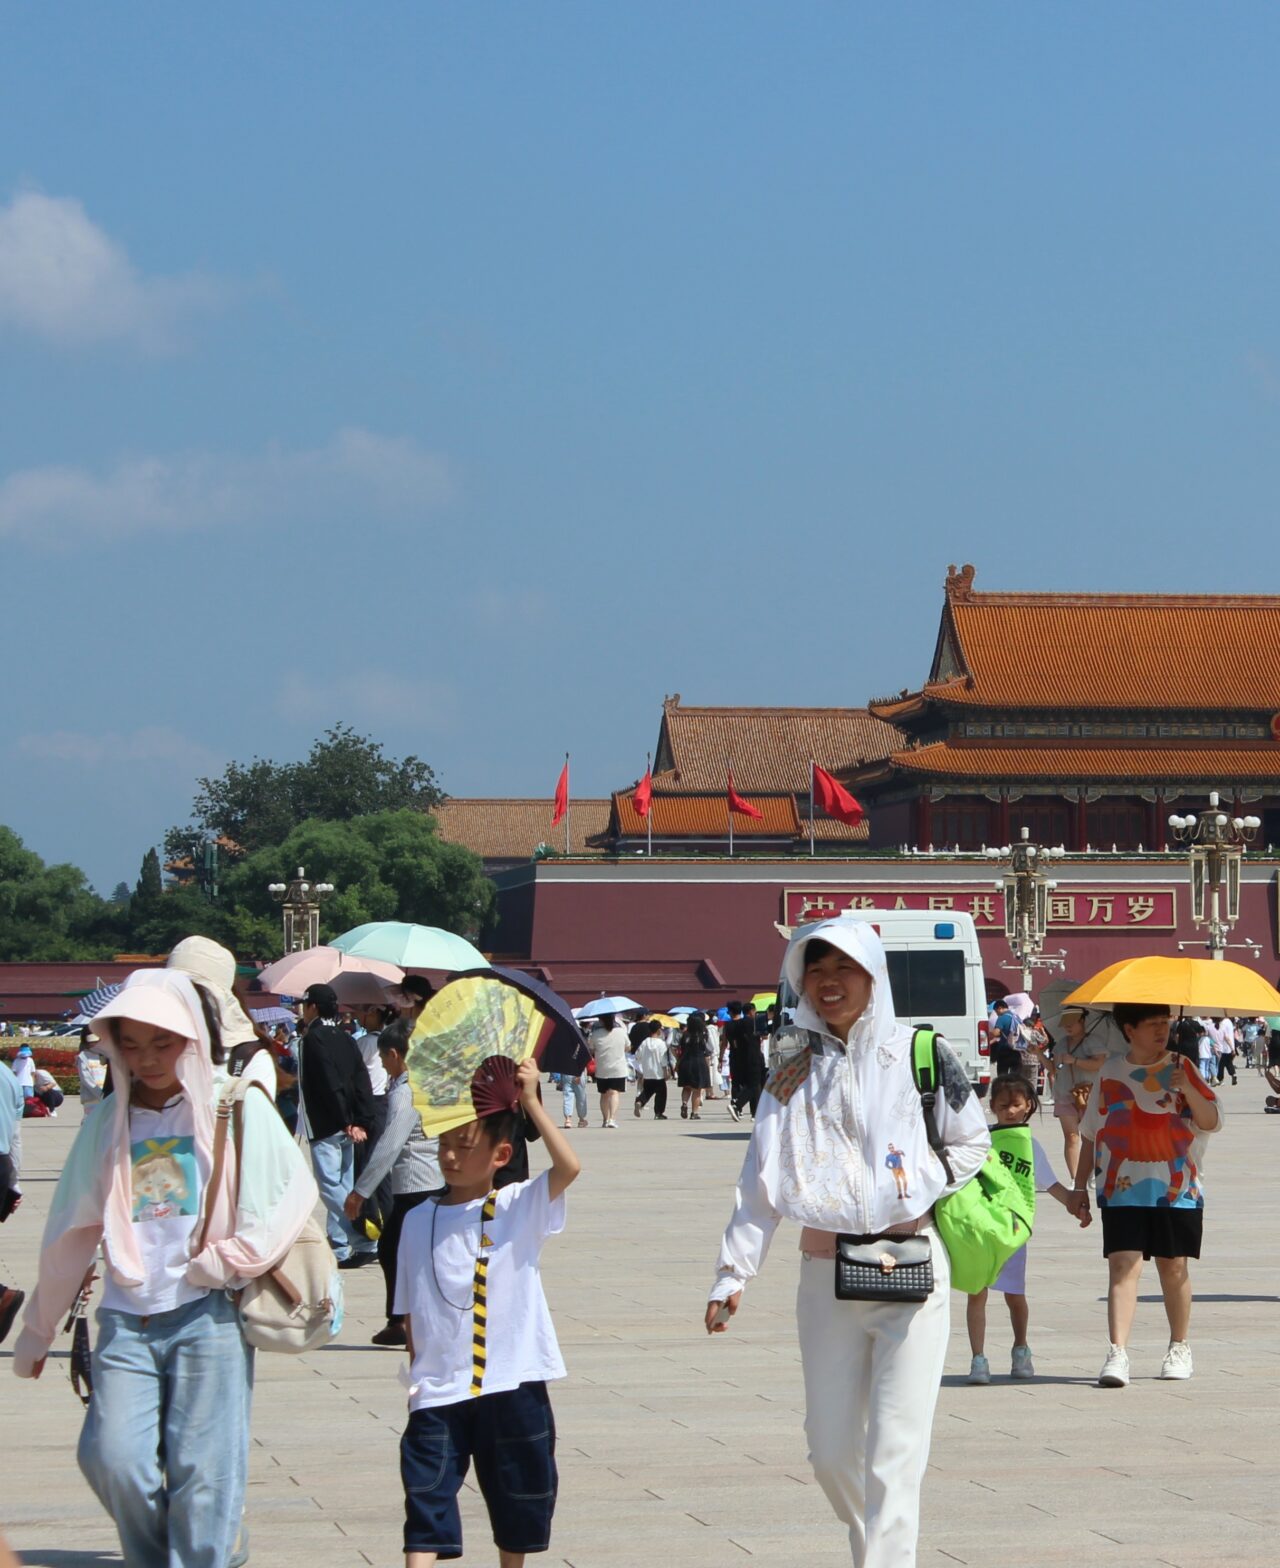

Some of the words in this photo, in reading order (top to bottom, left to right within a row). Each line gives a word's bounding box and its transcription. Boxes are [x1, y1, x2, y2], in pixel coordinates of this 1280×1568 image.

[807, 896, 1154, 922] 中华人民共国万岁
